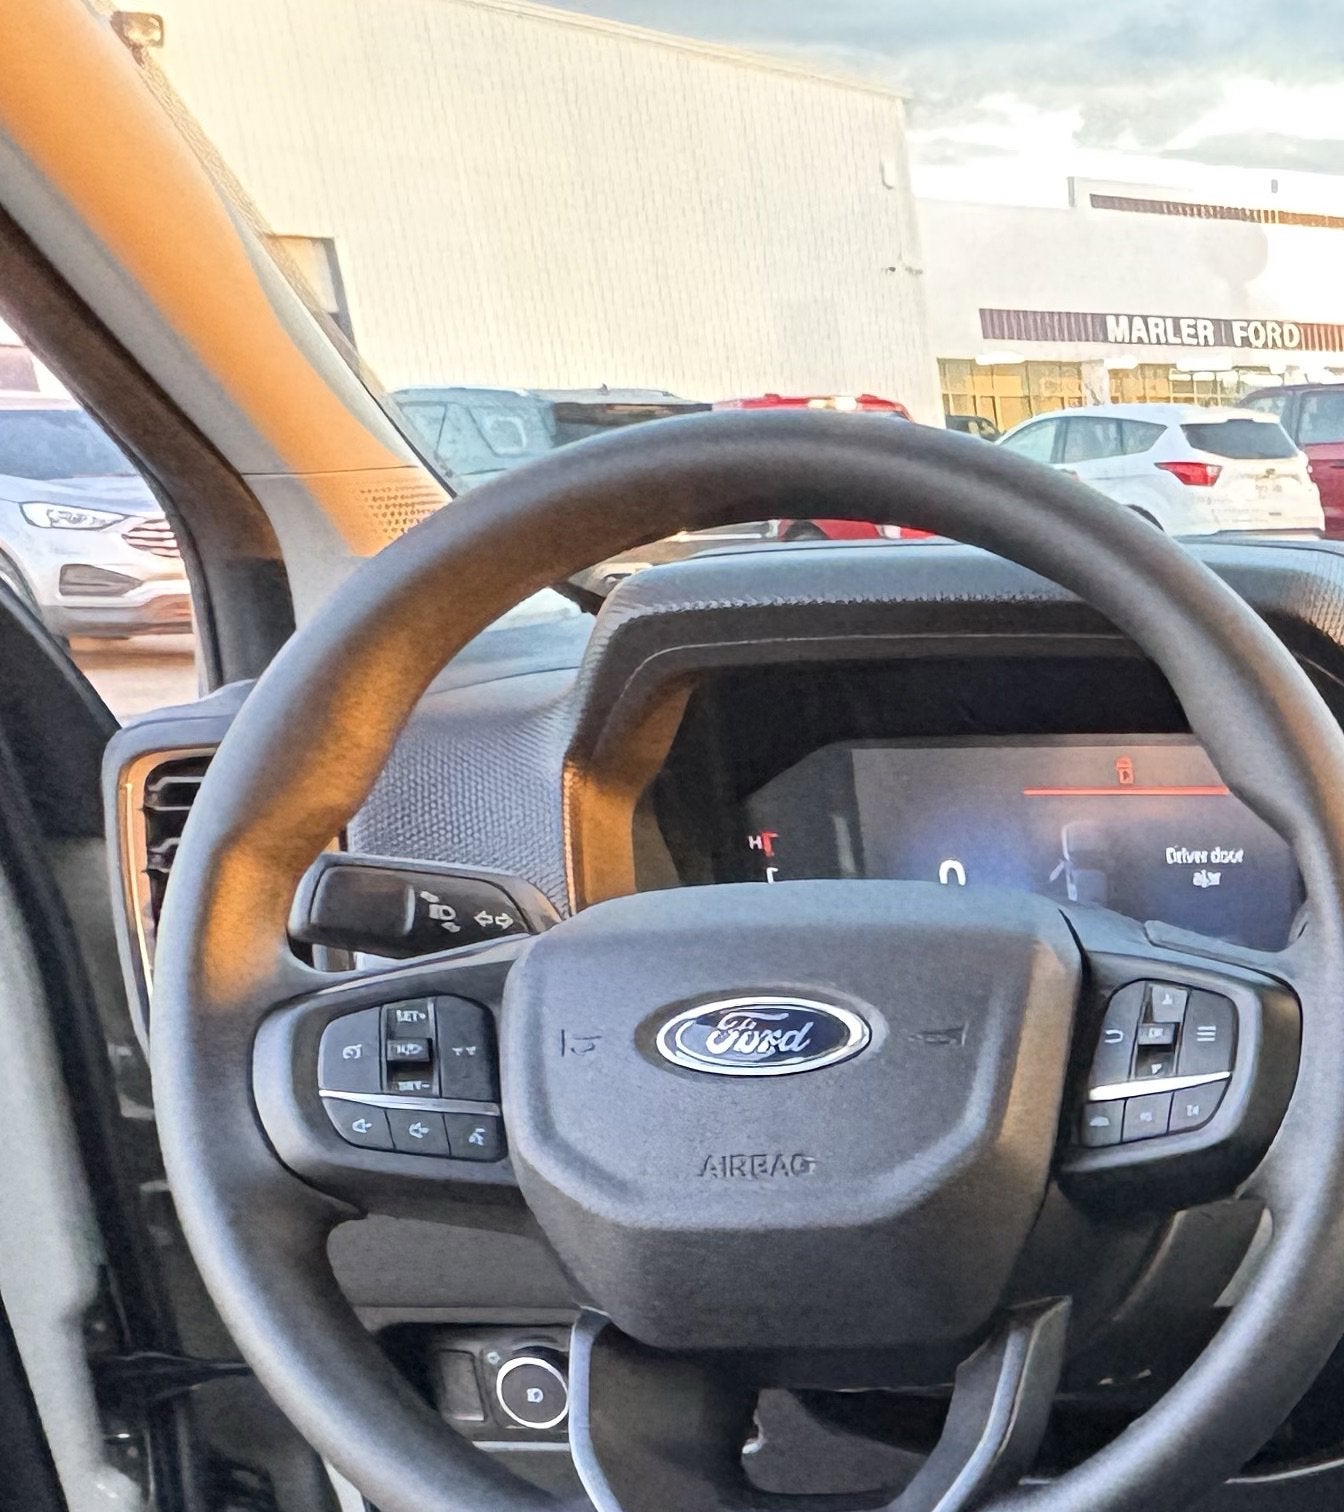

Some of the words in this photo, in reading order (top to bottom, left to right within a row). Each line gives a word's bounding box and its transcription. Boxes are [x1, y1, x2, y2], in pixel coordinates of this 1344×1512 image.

[1105, 315, 1215, 346] MARLER
[1232, 320, 1301, 348] FORD
[1165, 846, 1208, 864] Driver
[1210, 846, 1244, 864] door
[705, 1010, 815, 1055] Ford
[697, 1153, 818, 1179] AIRBAG
